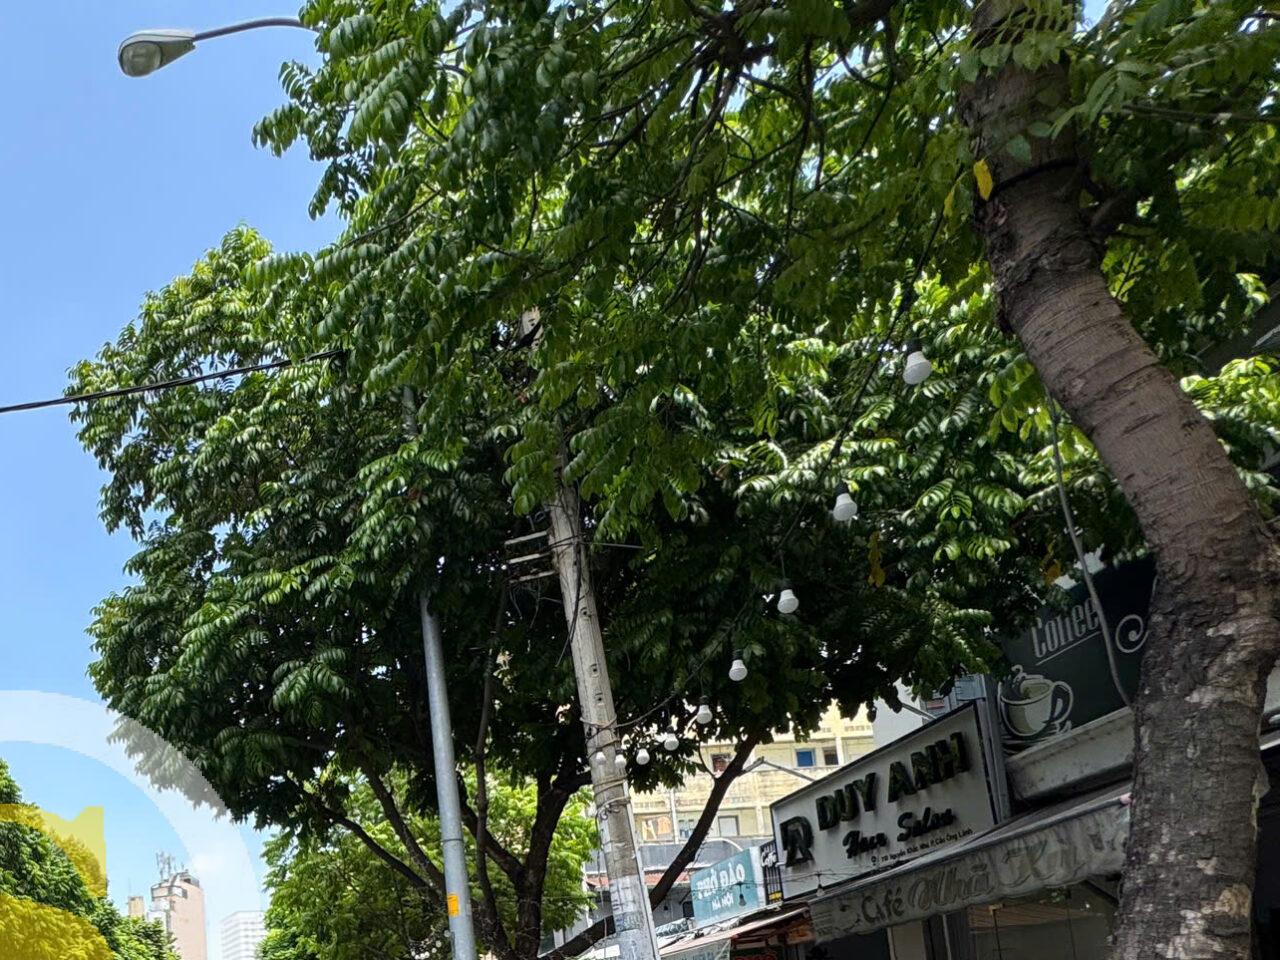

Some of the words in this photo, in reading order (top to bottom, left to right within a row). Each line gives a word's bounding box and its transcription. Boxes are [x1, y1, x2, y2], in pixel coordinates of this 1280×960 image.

[816, 772, 878, 831] DUY
[888, 731, 971, 803] ANH
[897, 806, 957, 842] Salon
